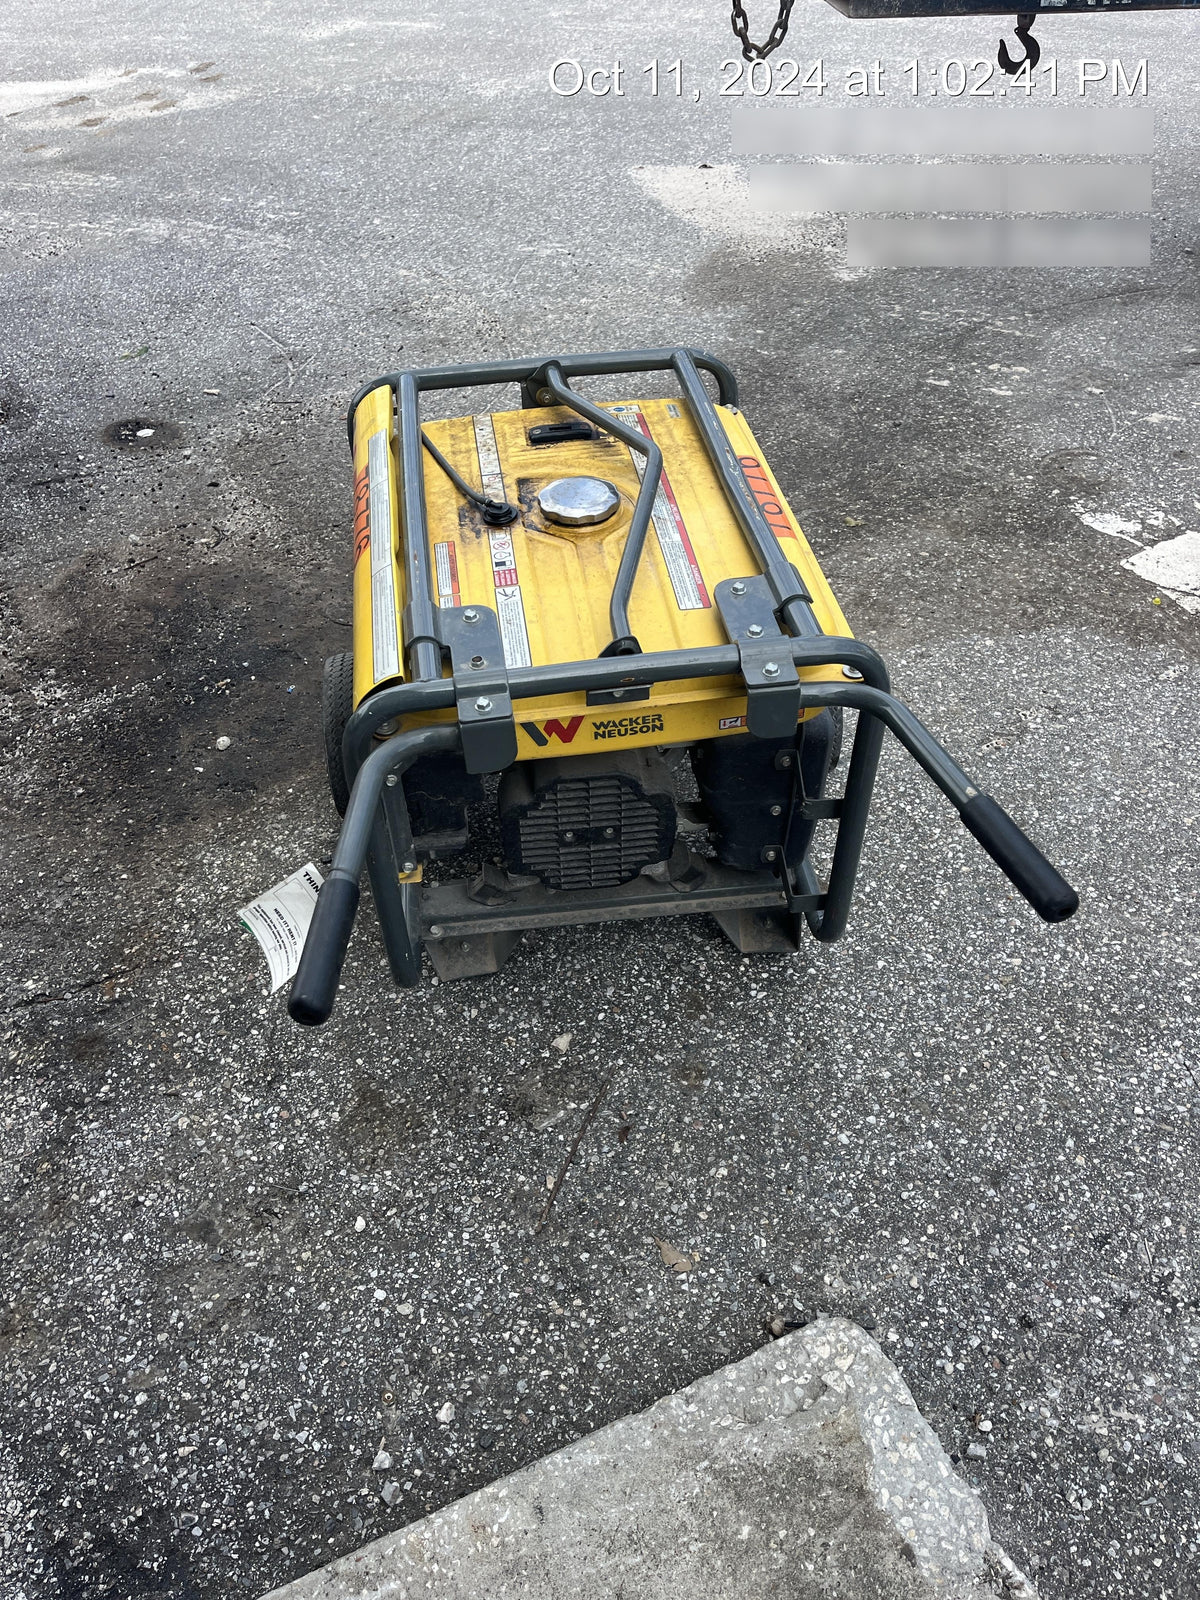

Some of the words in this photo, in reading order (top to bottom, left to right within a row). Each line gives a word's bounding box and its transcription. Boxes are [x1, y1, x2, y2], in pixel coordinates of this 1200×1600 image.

[692, 567, 702, 585] DANGER
[592, 714, 663, 730] WACKER
[594, 722, 664, 740] NEUSON
[303, 871, 321, 896] THIN
